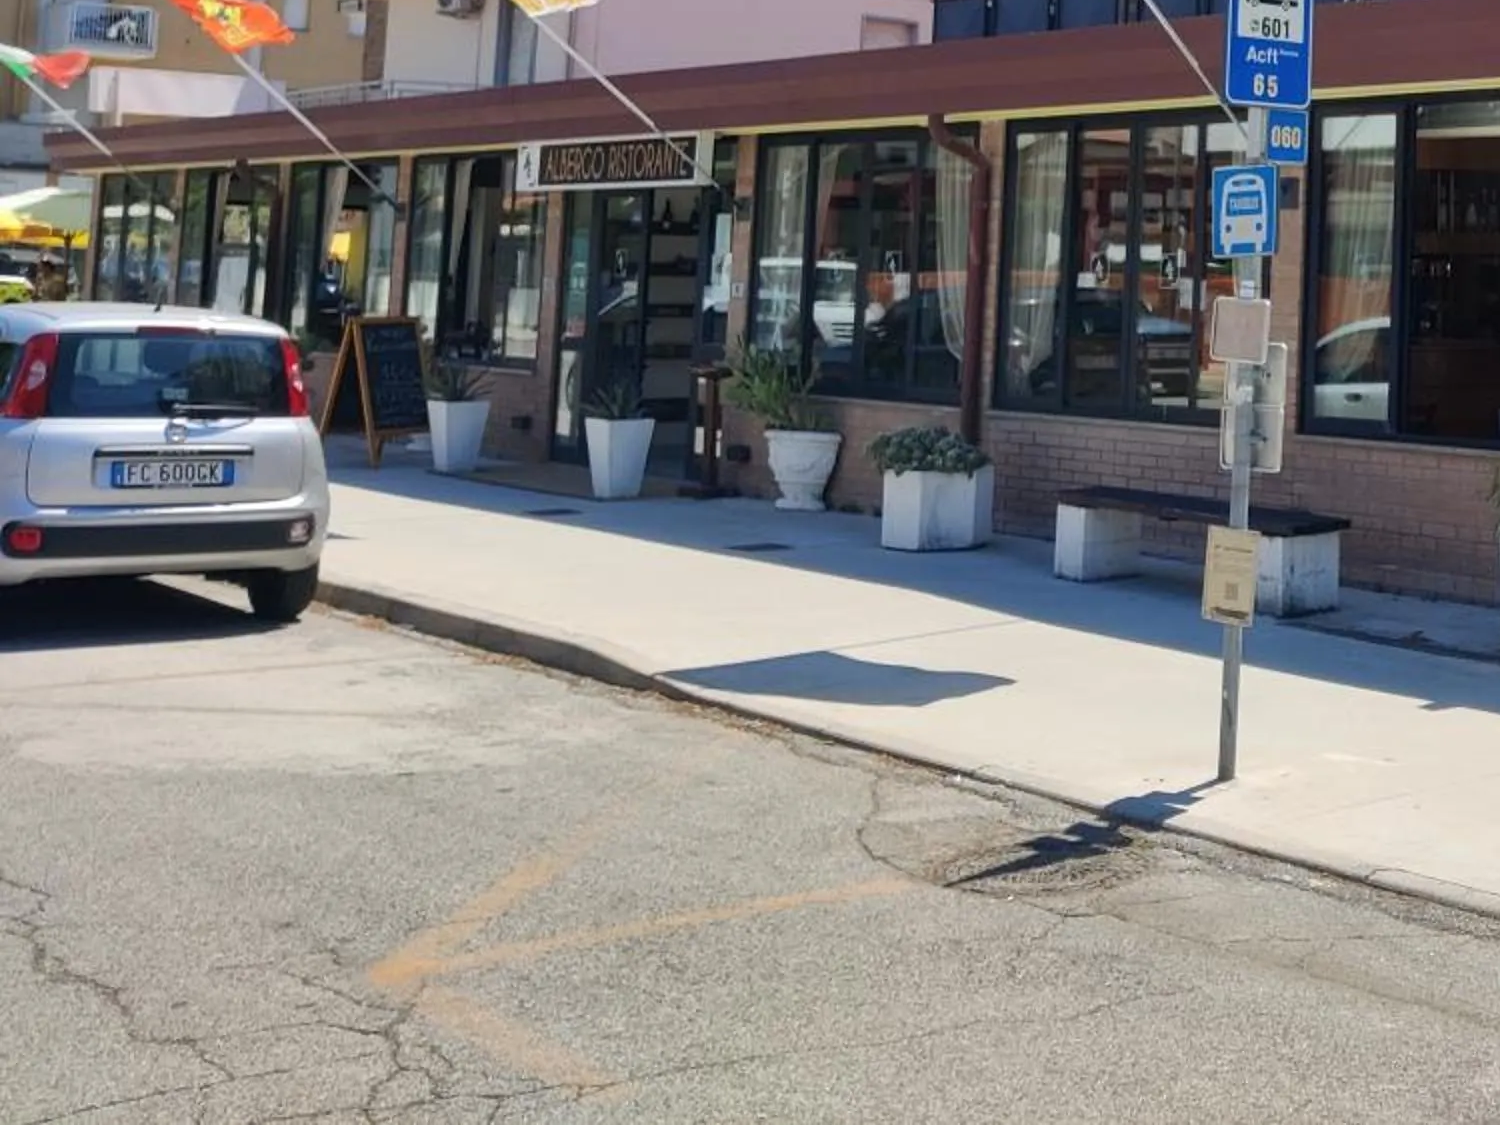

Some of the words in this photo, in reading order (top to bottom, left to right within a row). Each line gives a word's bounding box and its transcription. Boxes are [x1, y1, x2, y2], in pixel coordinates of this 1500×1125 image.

[1261, 16, 1290, 39] 601
[1245, 44, 1279, 64] Acft
[1253, 72, 1279, 98] 65
[1271, 124, 1302, 149] 060
[545, 146, 604, 181] ALBERGO
[607, 141, 689, 179] RISTORANTE
[127, 463, 151, 482] FC
